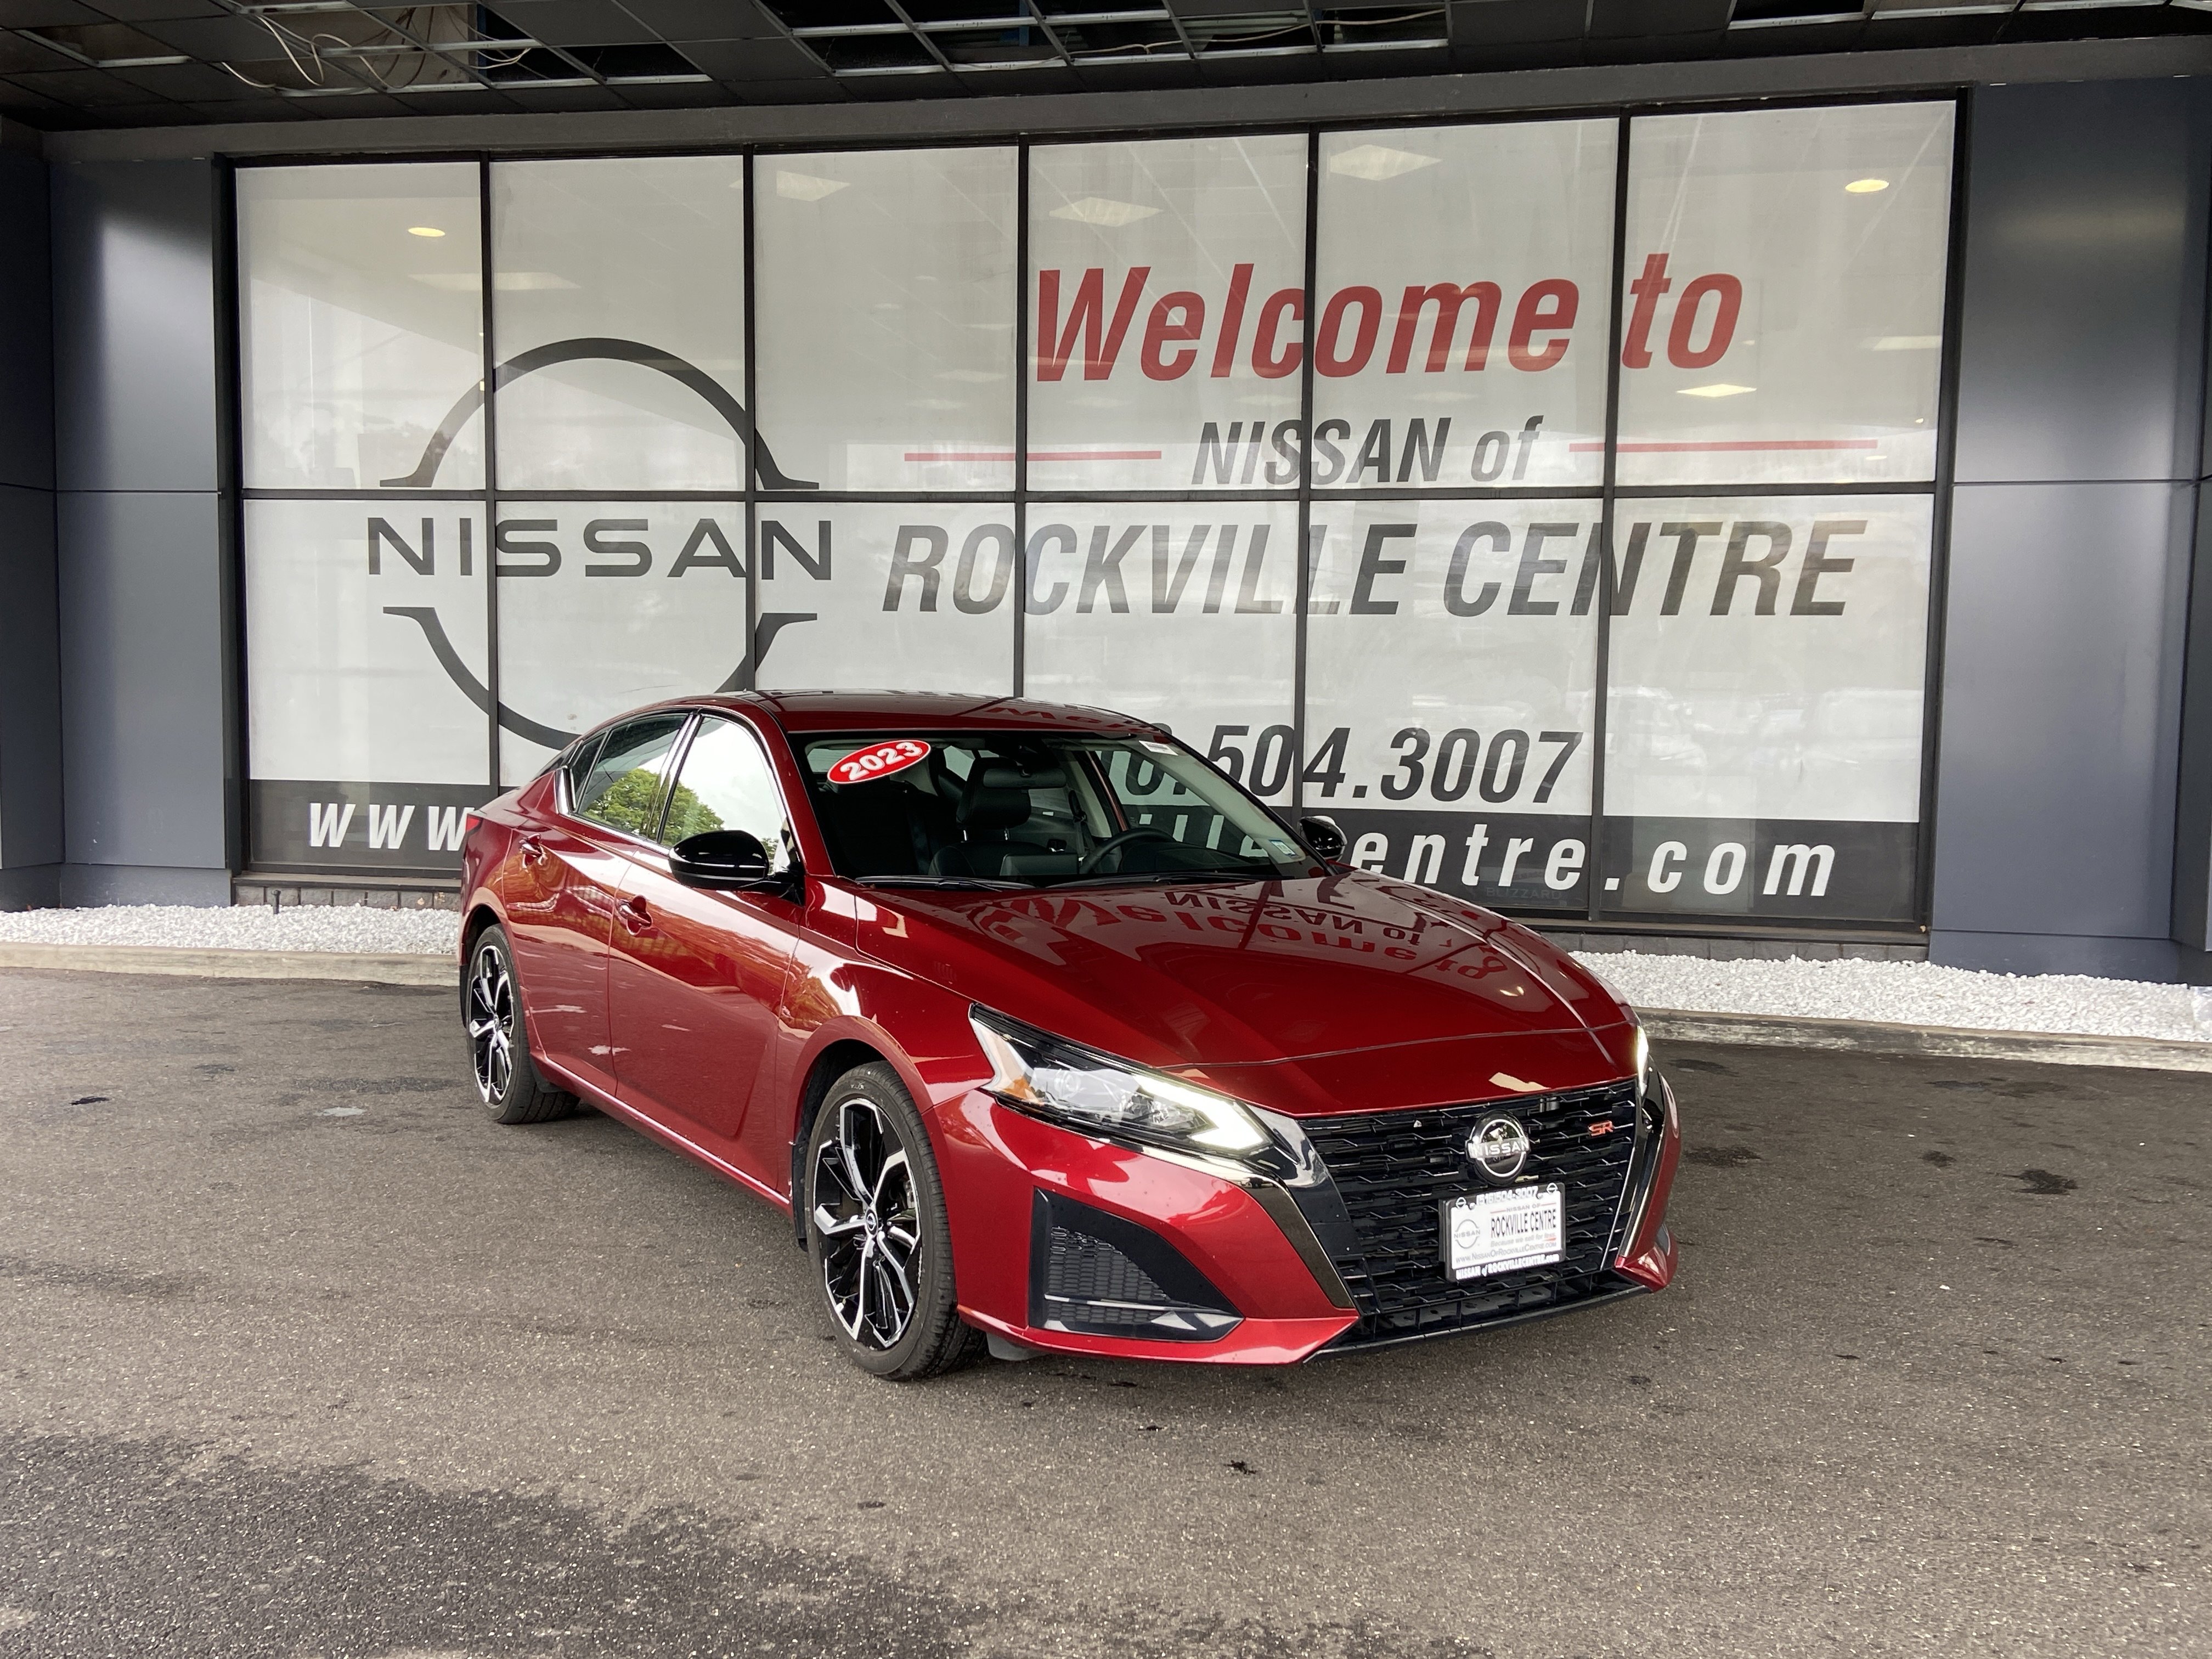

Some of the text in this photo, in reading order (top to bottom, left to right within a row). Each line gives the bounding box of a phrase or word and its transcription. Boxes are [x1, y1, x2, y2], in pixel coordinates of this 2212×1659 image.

[1036, 253, 1743, 382] Welcome to
[1192, 415, 1544, 486] NISSAN of
[368, 517, 832, 580] NISSAN
[882, 520, 1867, 617] ROCKVILLE CENTRE
[840, 741, 923, 781] 2023
[1587, 1120, 1615, 1137] SR
[1467, 1138, 1530, 1158] NISSAN
[1453, 1229, 1481, 1239] NISSAN
[1491, 1209, 1557, 1238] ROCKVILLE CENTRE
[1455, 1265, 1481, 1280] NISSAN
